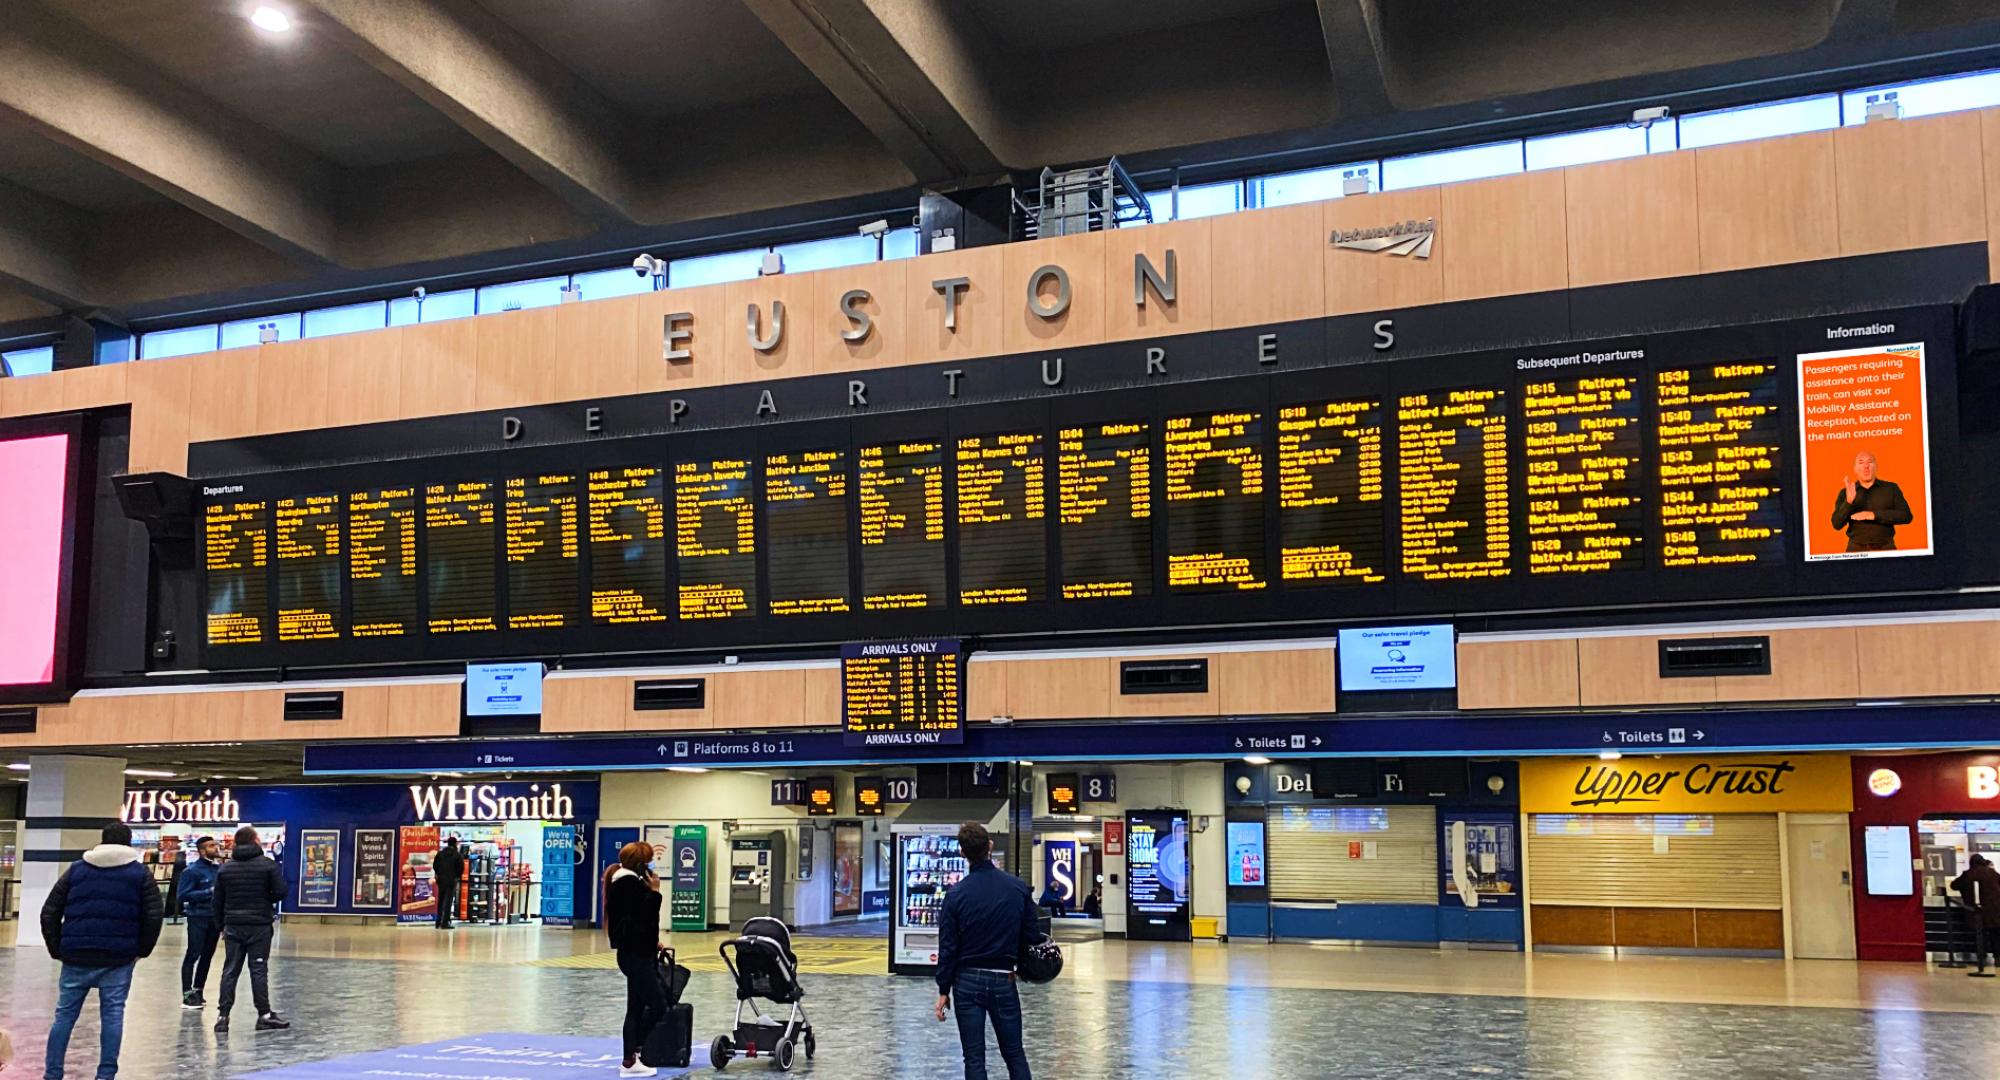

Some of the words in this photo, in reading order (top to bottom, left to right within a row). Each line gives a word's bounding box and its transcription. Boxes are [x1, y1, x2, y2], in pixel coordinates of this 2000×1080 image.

[1330, 218, 1435, 243] NetworkRail
[664, 249, 1177, 361] EUSTON
[1827, 323, 1895, 339] Information
[1517, 354, 1580, 369] Subsequent
[1583, 350, 1644, 364] Departures
[1805, 363, 1857, 375] Passengers
[1860, 359, 1903, 369] requiring
[503, 319, 1395, 442] DEPARTURES
[1659, 371, 1689, 383] 15:34
[1715, 365, 1764, 378] Platform
[1806, 378, 1854, 388] assistance
[1857, 375, 1879, 383] onto
[1882, 372, 1904, 380] their
[1527, 383, 1555, 394] 15:15
[1579, 378, 1625, 390] Platform
[1658, 385, 1688, 396] Tring
[1400, 396, 1427, 407] 15:15
[1450, 392, 1493, 402] Platform
[1525, 395, 1575, 408] Birmingham
[1578, 393, 1597, 403] New
[1600, 391, 1612, 401] St
[1615, 389, 1631, 399] via
[1806, 393, 1830, 401] train,
[1853, 388, 1872, 396] visit
[1280, 408, 1307, 418] 15:10
[1328, 402, 1369, 414] Platform
[1399, 407, 1438, 420] Watford
[1442, 404, 1484, 416] Junction
[1807, 404, 1846, 414] Mobility
[1849, 399, 1900, 410] Assistance
[1167, 419, 1191, 429] 15:07
[1212, 414, 1251, 425] Platform
[1661, 411, 1691, 423] 15:40
[1716, 406, 1765, 418] Platform
[1808, 418, 1857, 428] Reception,
[1860, 412, 1895, 423] located
[1279, 420, 1316, 430] Glasgow
[1319, 415, 1356, 427] Central
[1528, 422, 1557, 434] 15:20
[1581, 418, 1626, 429] Platform
[1659, 422, 1724, 436] Manchester
[1728, 420, 1752, 430] Picc
[1060, 429, 1083, 439] 15:04
[1102, 425, 1139, 435] Platform
[1166, 429, 1207, 441] Liverpool
[1210, 428, 1230, 437] Lime
[1233, 426, 1244, 435] St
[1526, 433, 1588, 446] Manchester
[1592, 431, 1614, 441] Picc
[1808, 432, 1824, 441] the
[1827, 432, 1850, 440] main
[1854, 428, 1903, 438] concourse
[900, 444, 932, 453] Platform
[958, 439, 980, 448] 14:52
[999, 435, 1033, 445] Platform
[1059, 442, 1082, 451] Tring
[767, 456, 787, 465] 14:45
[804, 453, 836, 462] Platform
[957, 450, 980, 460] Milton
[982, 448, 1012, 458] Keynes
[1662, 451, 1693, 463] 15:43
[1717, 447, 1767, 458] Platform
[676, 464, 697, 472] 14:43
[713, 461, 744, 470] Platform
[766, 465, 795, 476] Watford
[799, 464, 829, 473] Junction
[859, 459, 884, 468] Crewe
[1529, 461, 1558, 473] 15:23
[1582, 457, 1628, 469] Platform
[1661, 462, 1712, 476] Blackpool
[1716, 460, 1750, 472] North
[1753, 459, 1771, 469] via
[539, 476, 568, 485] Platform
[589, 471, 608, 480] 14:40
[624, 469, 654, 477] Platform
[676, 471, 712, 483] Edinburgh
[715, 471, 746, 480] Waverley
[1528, 473, 1584, 485] Birmingham
[1588, 471, 1609, 481] New
[1613, 469, 1625, 479] St
[204, 485, 243, 495] Departures
[506, 489, 524, 498] Tring
[1664, 491, 1694, 503] 15:44
[1719, 487, 1769, 499] Platform
[1530, 501, 1559, 512] 15:24
[1583, 497, 1629, 508] Platform
[1662, 503, 1707, 516] Watford
[1711, 501, 1758, 513] Junction
[1529, 511, 1598, 524] Northampton
[1721, 528, 1770, 540] Platform
[1585, 536, 1631, 548] Platform
[1531, 551, 1572, 564] Watford
[1577, 549, 1621, 561] Junction
[1664, 546, 1698, 556] Crewe
[862, 644, 908, 655] ARRIVALS
[911, 642, 937, 652] ONLY
[866, 734, 911, 744] ARRIVALS
[914, 733, 940, 743] ONLY
[1249, 738, 1286, 748] Toilets
[1619, 732, 1663, 742] Toilets
[694, 743, 750, 755] Platforms
[752, 743, 760, 753] 8
[763, 743, 775, 753] to
[779, 741, 794, 753] 11
[494, 755, 513, 763] Tickets
[1089, 779, 1102, 797] 8
[1277, 773, 1312, 792] Del
[1574, 766, 1680, 806] Upper
[1684, 761, 1795, 795] Crust
[1968, 766, 2000, 798] B
[774, 783, 790, 800] 11
[888, 781, 908, 799] 10
[410, 784, 574, 821] WHSmith
[548, 831, 570, 839] We're
[1132, 833, 1154, 847] STAY
[545, 840, 572, 848] OPEN
[1052, 848, 1071, 860] WH
[1132, 848, 1158, 862] HOME
[1052, 860, 1073, 900] S
[872, 897, 883, 906] Keep
